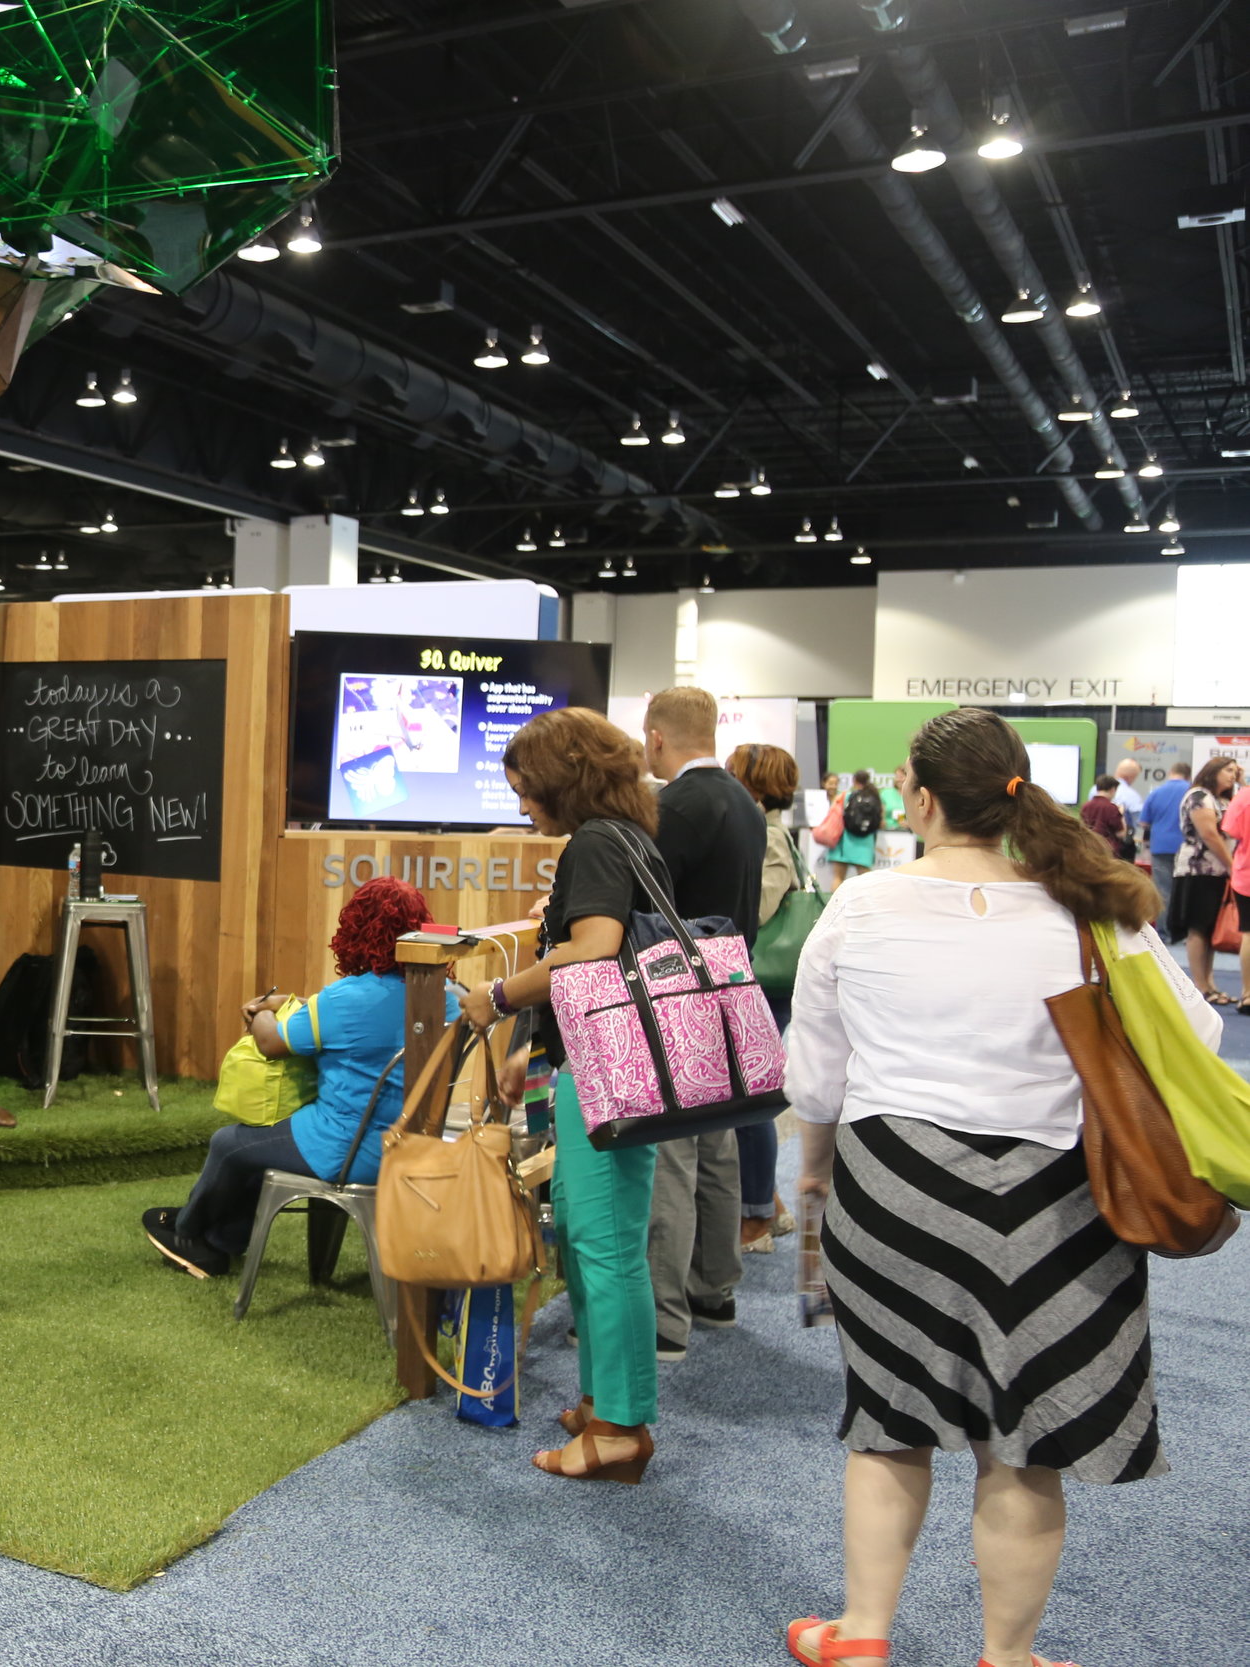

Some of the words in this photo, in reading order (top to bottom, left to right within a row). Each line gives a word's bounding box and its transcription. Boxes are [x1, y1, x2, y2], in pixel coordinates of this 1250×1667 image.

[419, 648, 446, 670] 30.
[449, 649, 503, 672] Quiver
[25, 675, 108, 734] today
[107, 683, 138, 707] is
[145, 678, 181, 707] a
[906, 678, 1058, 697] EMERGENCY
[1069, 678, 1124, 697] EXIT
[36, 754, 77, 782] to
[76, 756, 153, 795] learn
[5, 791, 134, 831] SOMETHING
[150, 792, 209, 832] NEW!
[323, 854, 558, 892] SQUIRRELS
[653, 965, 685, 977] SCOUT
